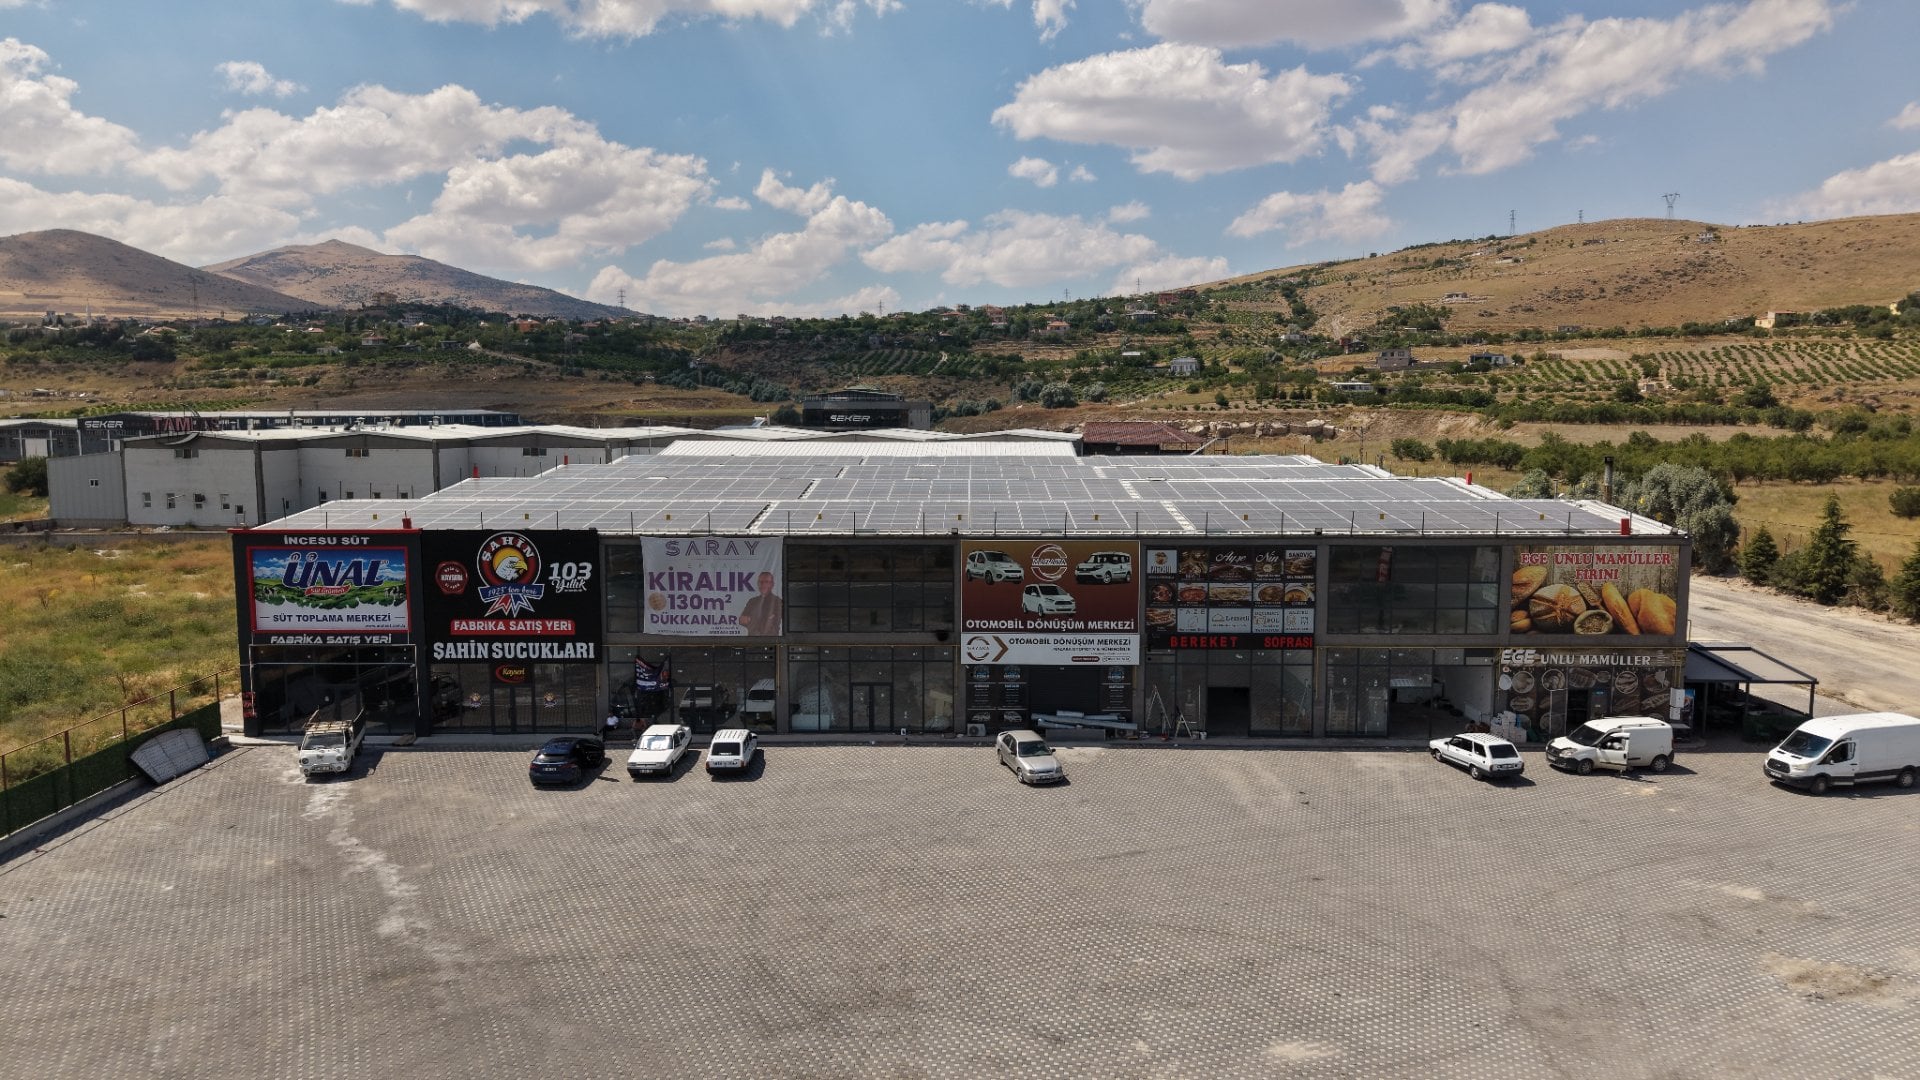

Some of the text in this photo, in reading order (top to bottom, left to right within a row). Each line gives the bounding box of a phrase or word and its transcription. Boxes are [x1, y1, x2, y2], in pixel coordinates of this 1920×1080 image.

[284, 534, 370, 545] İNCESU SÜT
[665, 540, 760, 557] SARAY
[1520, 550, 1672, 565] EGE UNLU MAMÜLLER
[282, 551, 385, 588] ÜNAL
[549, 562, 593, 581] 103
[648, 566, 756, 592] KİRALIK
[273, 612, 392, 623] SÜT TOPLAMA MERKEZİ
[650, 611, 738, 625] DÜKKANLAR
[966, 618, 1135, 631] OTOMOBİL DÖNÜŞÜM MERKEZİ
[454, 619, 572, 634] FABRİKA SATIŞ YERİ
[270, 633, 392, 646] FABRİKA SATIŞ YERİ
[1008, 636, 1131, 646] OTOMOBİL DÖNÜŞÜM MERKEZİ
[1170, 635, 1313, 648] BEREKET SOFRASI
[433, 640, 595, 660] ŞAHİN SUCUKLARI
[1500, 649, 1651, 666] EGE UNLU MAMÜLLER
